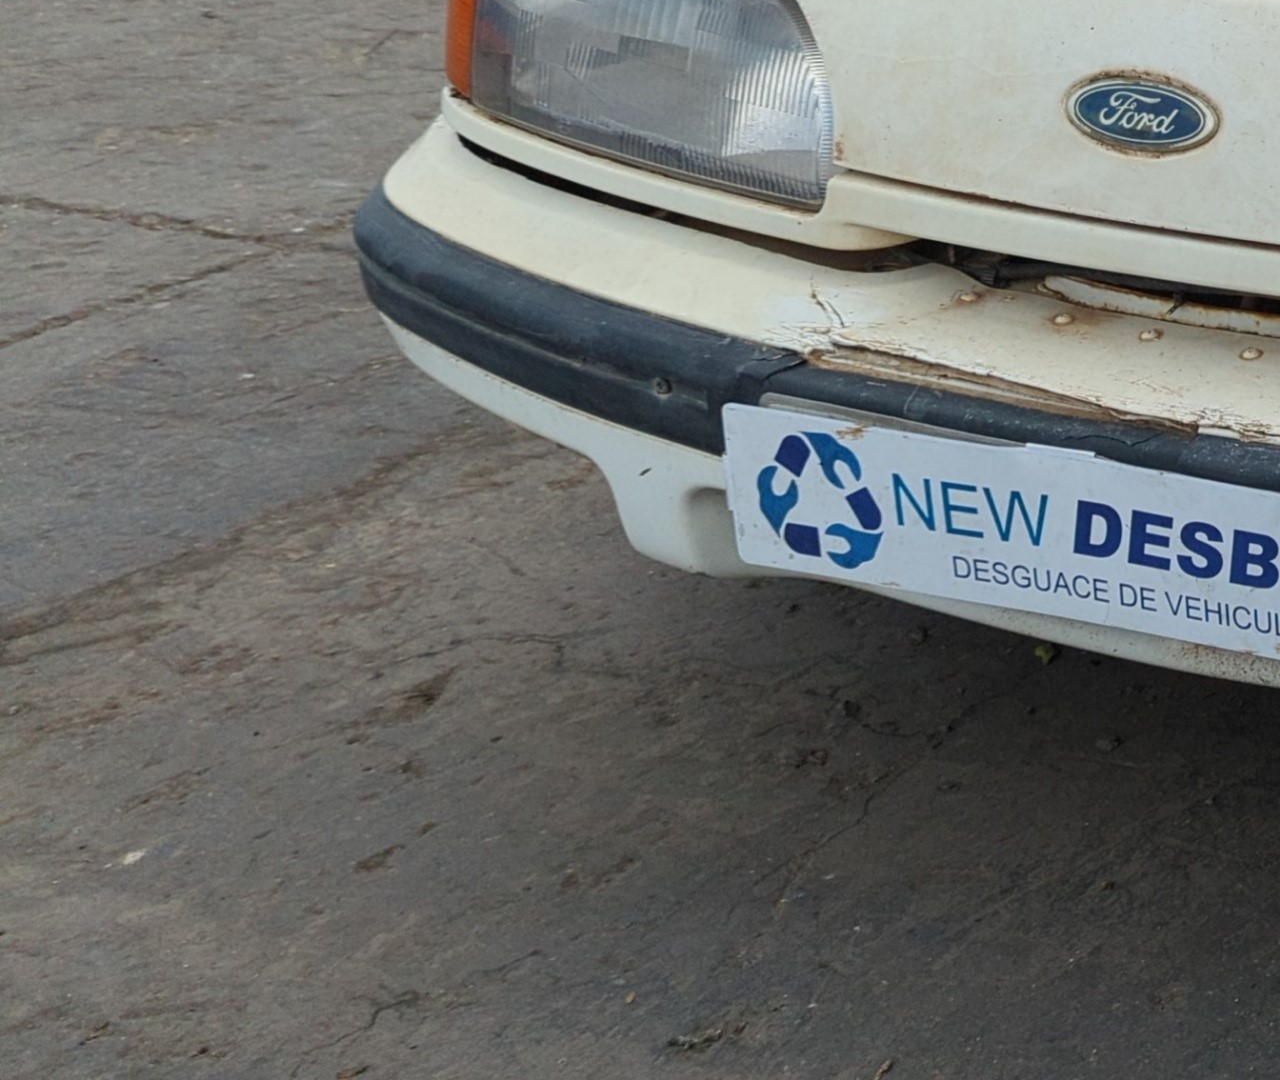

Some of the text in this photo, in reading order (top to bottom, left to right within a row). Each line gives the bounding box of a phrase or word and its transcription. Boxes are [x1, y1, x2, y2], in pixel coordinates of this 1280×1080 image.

[1098, 90, 1180, 135] Ford
[893, 473, 1048, 547] NEW
[953, 556, 1110, 604] DESGUACE
[1120, 583, 1158, 613] DE
